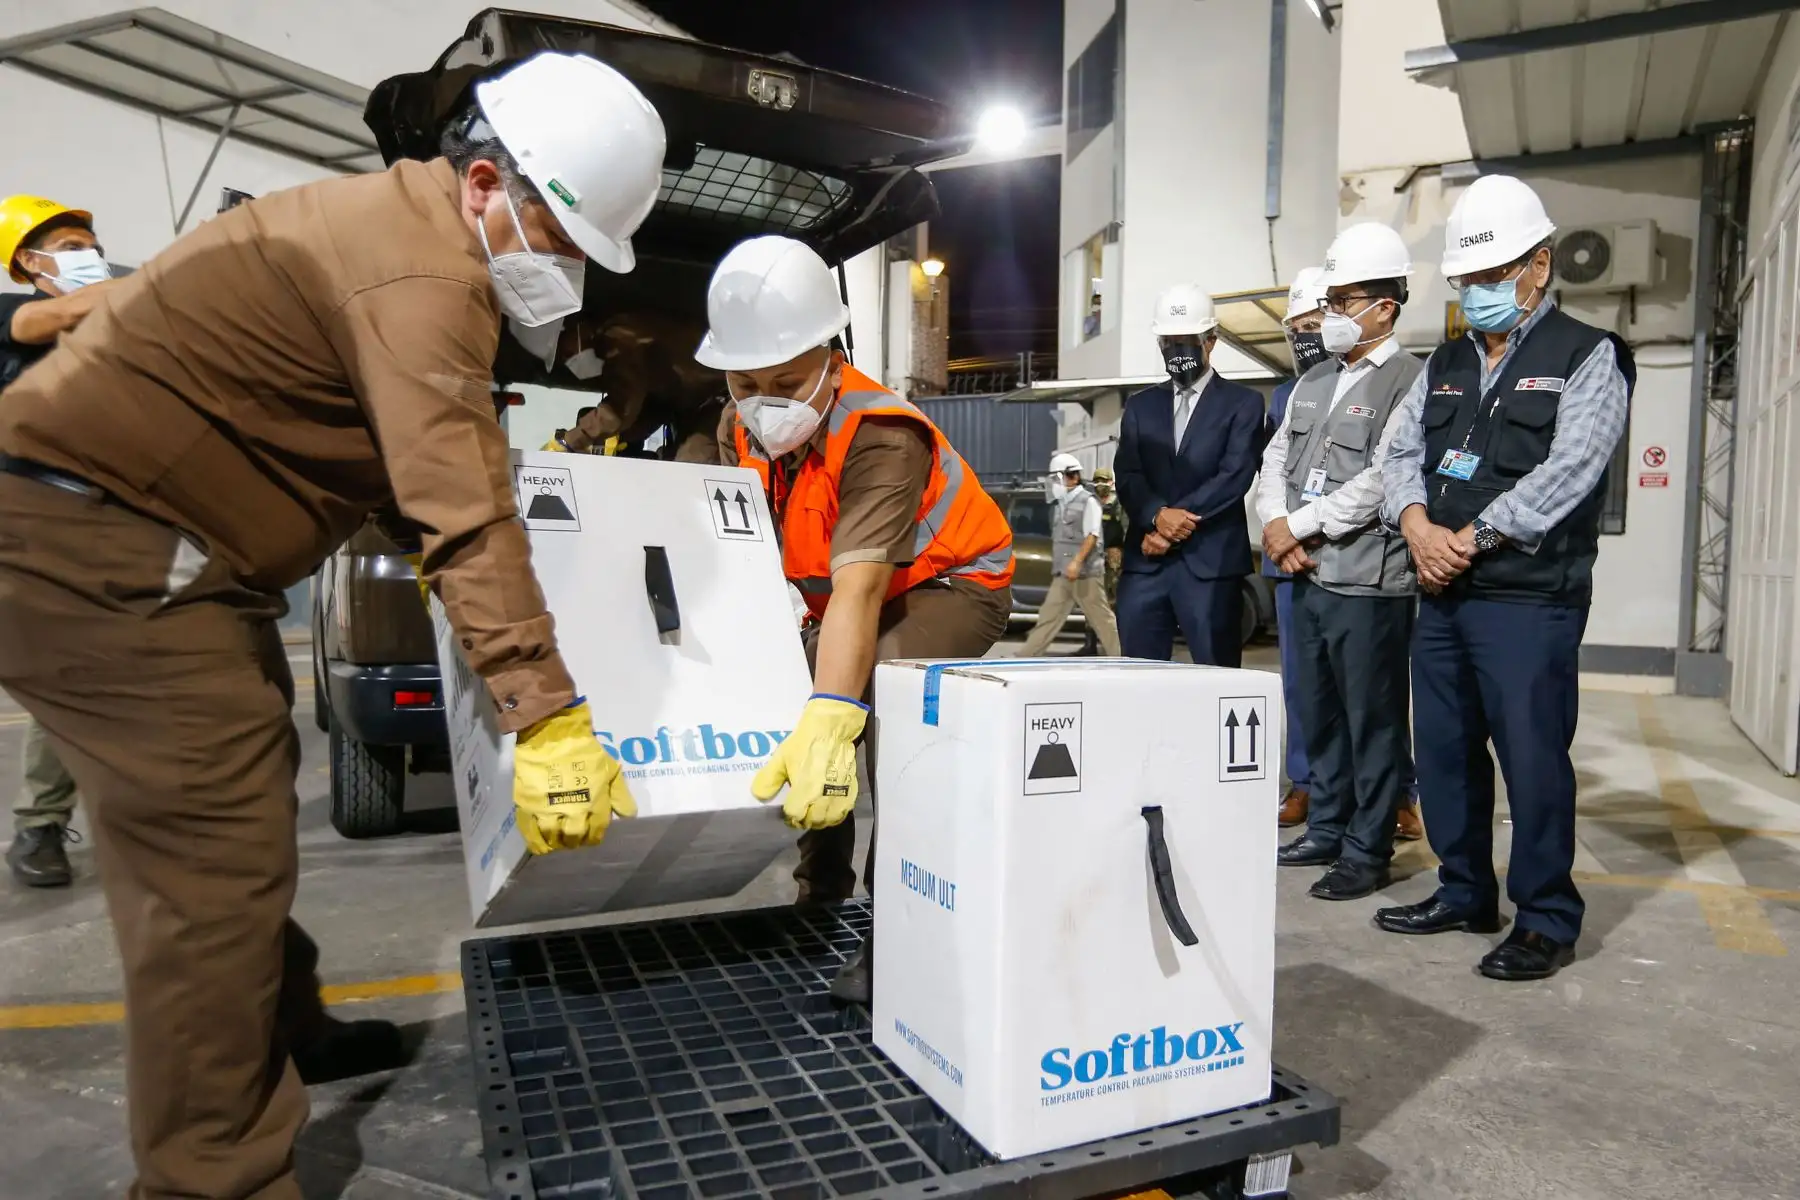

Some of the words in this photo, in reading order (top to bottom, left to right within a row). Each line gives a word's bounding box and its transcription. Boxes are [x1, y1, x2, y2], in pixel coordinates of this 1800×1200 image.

[1460, 230, 1494, 248] CENARES
[1181, 360, 1198, 371] WIN
[523, 476, 565, 486] HEAVY
[1031, 717, 1075, 730] HEAVY
[650, 767, 684, 777] CONTROL
[687, 764, 730, 775] PACKAGING
[901, 858, 936, 902] MEDIUM
[939, 877, 956, 912] ULT
[1041, 1022, 1245, 1091] Softbox
[1041, 1088, 1095, 1107] TEMPERATURE
[1097, 1081, 1131, 1096] CONTROL
[1132, 1072, 1173, 1088] PACKAGING
[1175, 1064, 1206, 1078] SYSTEMS
